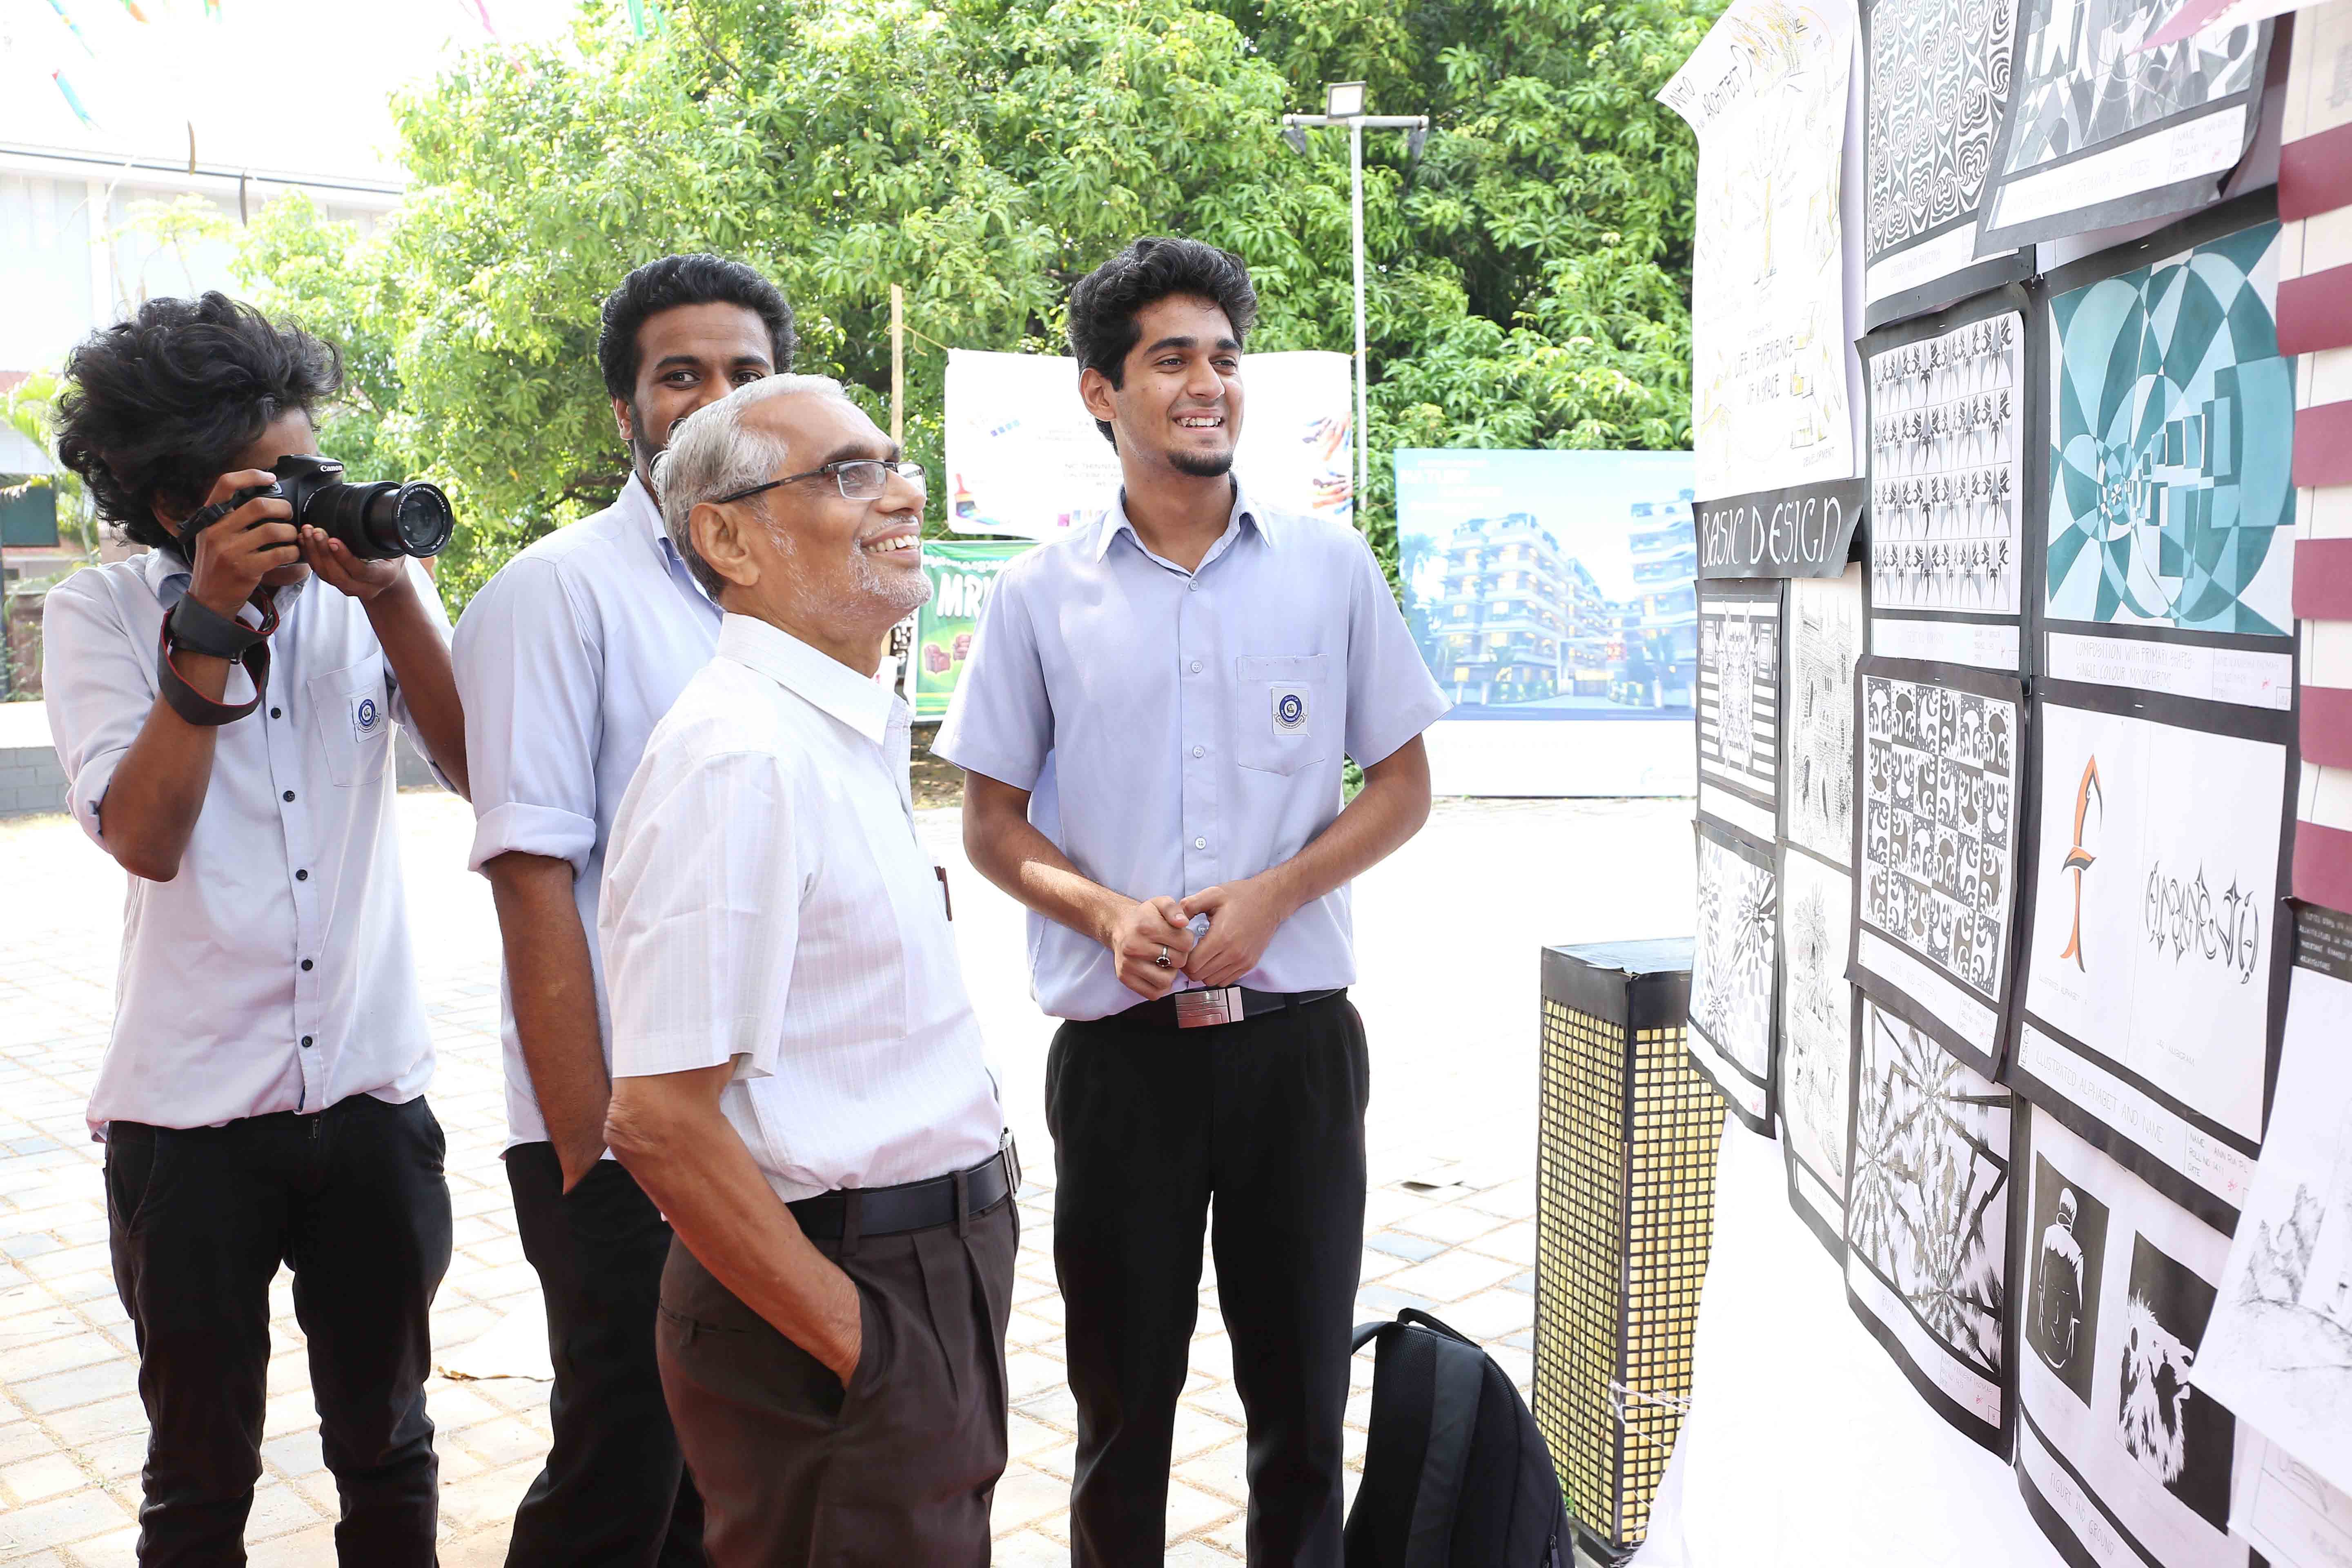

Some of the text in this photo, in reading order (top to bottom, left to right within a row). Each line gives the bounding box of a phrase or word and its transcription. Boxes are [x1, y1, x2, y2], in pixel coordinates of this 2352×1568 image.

[1666, 76, 1695, 109] WHO
[1702, 496, 1842, 568] BASIC DESIGN
[936, 572, 991, 618] MR
[2075, 641, 2121, 660] COMPOSITION
[2123, 645, 2140, 663] WITH
[2076, 662, 2097, 679] SINGLE
[2099, 663, 2126, 681] COLOUR
[2020, 1028, 2030, 1067] IESCA
[2079, 1077, 2119, 1112] ALPHABET
[2121, 1103, 2139, 1127] AND
[2142, 1115, 2164, 1144] NAME
[2187, 1163, 2201, 1177] DATE
[2049, 1472, 2071, 1507] FIGURE
[2088, 1519, 2114, 1556] GROUND
